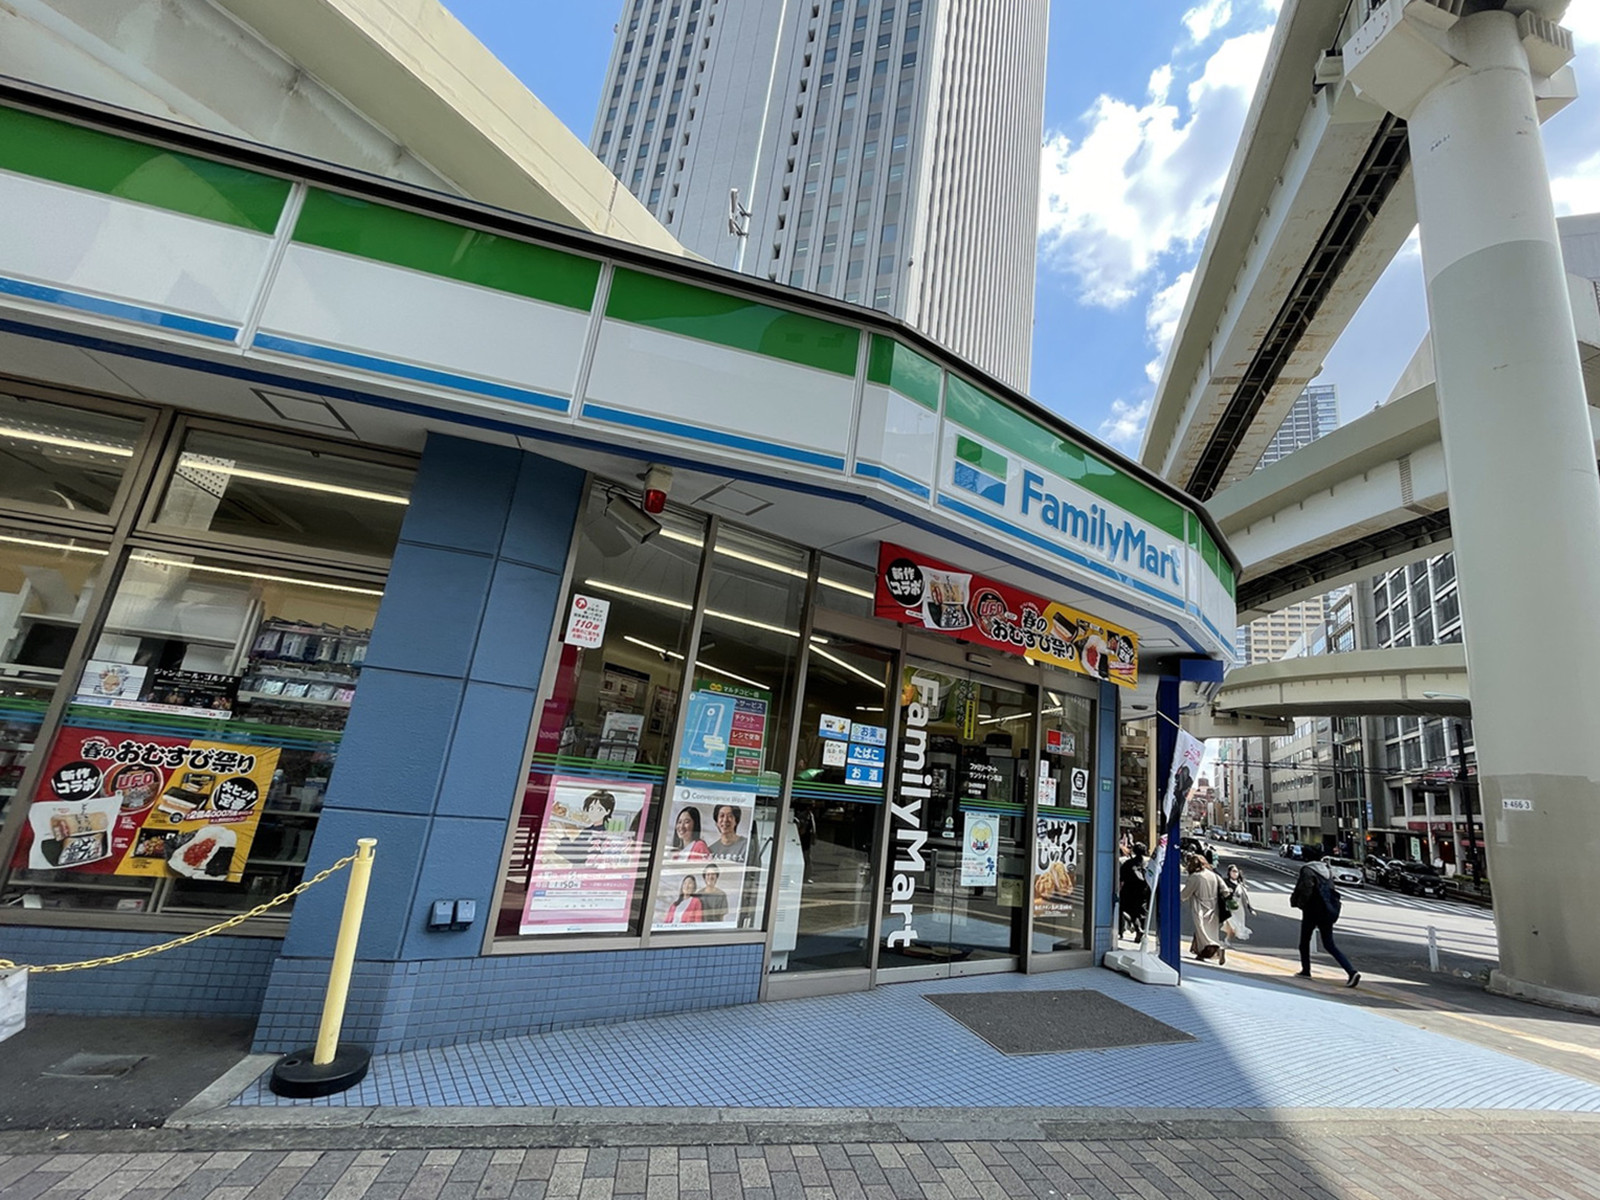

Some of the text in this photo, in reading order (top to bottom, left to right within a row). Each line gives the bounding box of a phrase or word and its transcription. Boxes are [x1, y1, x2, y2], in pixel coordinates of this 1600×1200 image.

[1020, 469, 1181, 587] FamilyMart
[891, 566, 916, 581] 新作
[889, 579, 922, 596] コラボ
[1022, 608, 1048, 633] 春の
[991, 617, 1076, 661] おむすび祭り
[81, 739, 256, 774] 春のおむすび祭り
[854, 746, 880, 760] たばこ
[60, 767, 92, 781] 新作
[57, 776, 98, 794] コラボ
[222, 782, 257, 801] 大ヒット
[887, 675, 940, 949] FamilyMart
